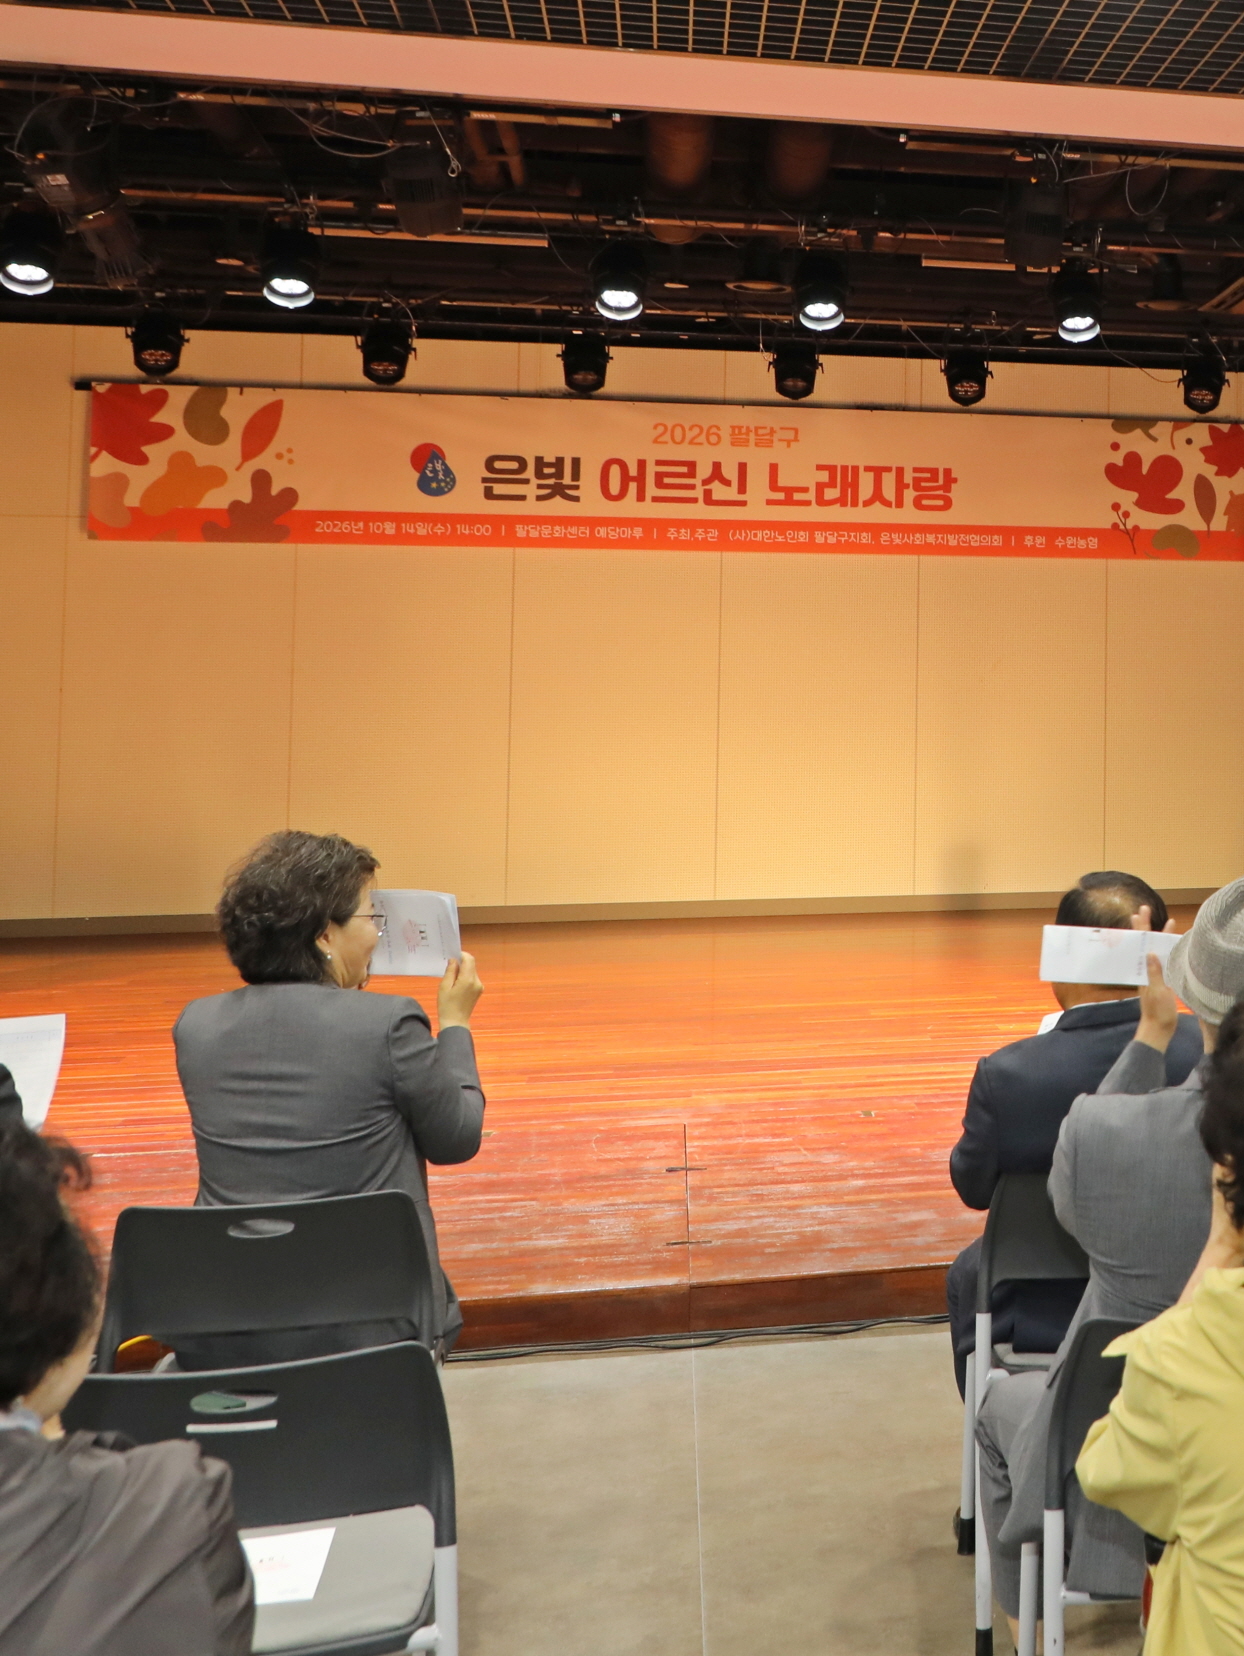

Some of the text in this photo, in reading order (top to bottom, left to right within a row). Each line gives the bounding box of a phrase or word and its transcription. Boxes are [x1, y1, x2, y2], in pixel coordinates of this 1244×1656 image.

[652, 422, 800, 448] 2026 팔달구
[481, 454, 958, 512] 은빛 어르신 노래자랑
[315, 521, 364, 534] 2026년
[369, 522, 396, 535] 10월
[401, 522, 451, 536] 14일(수)
[456, 524, 492, 536] 14:00
[515, 524, 590, 539] 팔달문화센터
[729, 529, 809, 543] (사)대한노인회
[1024, 535, 1046, 548] 후원
[1054, 536, 1098, 549] 수원농협
